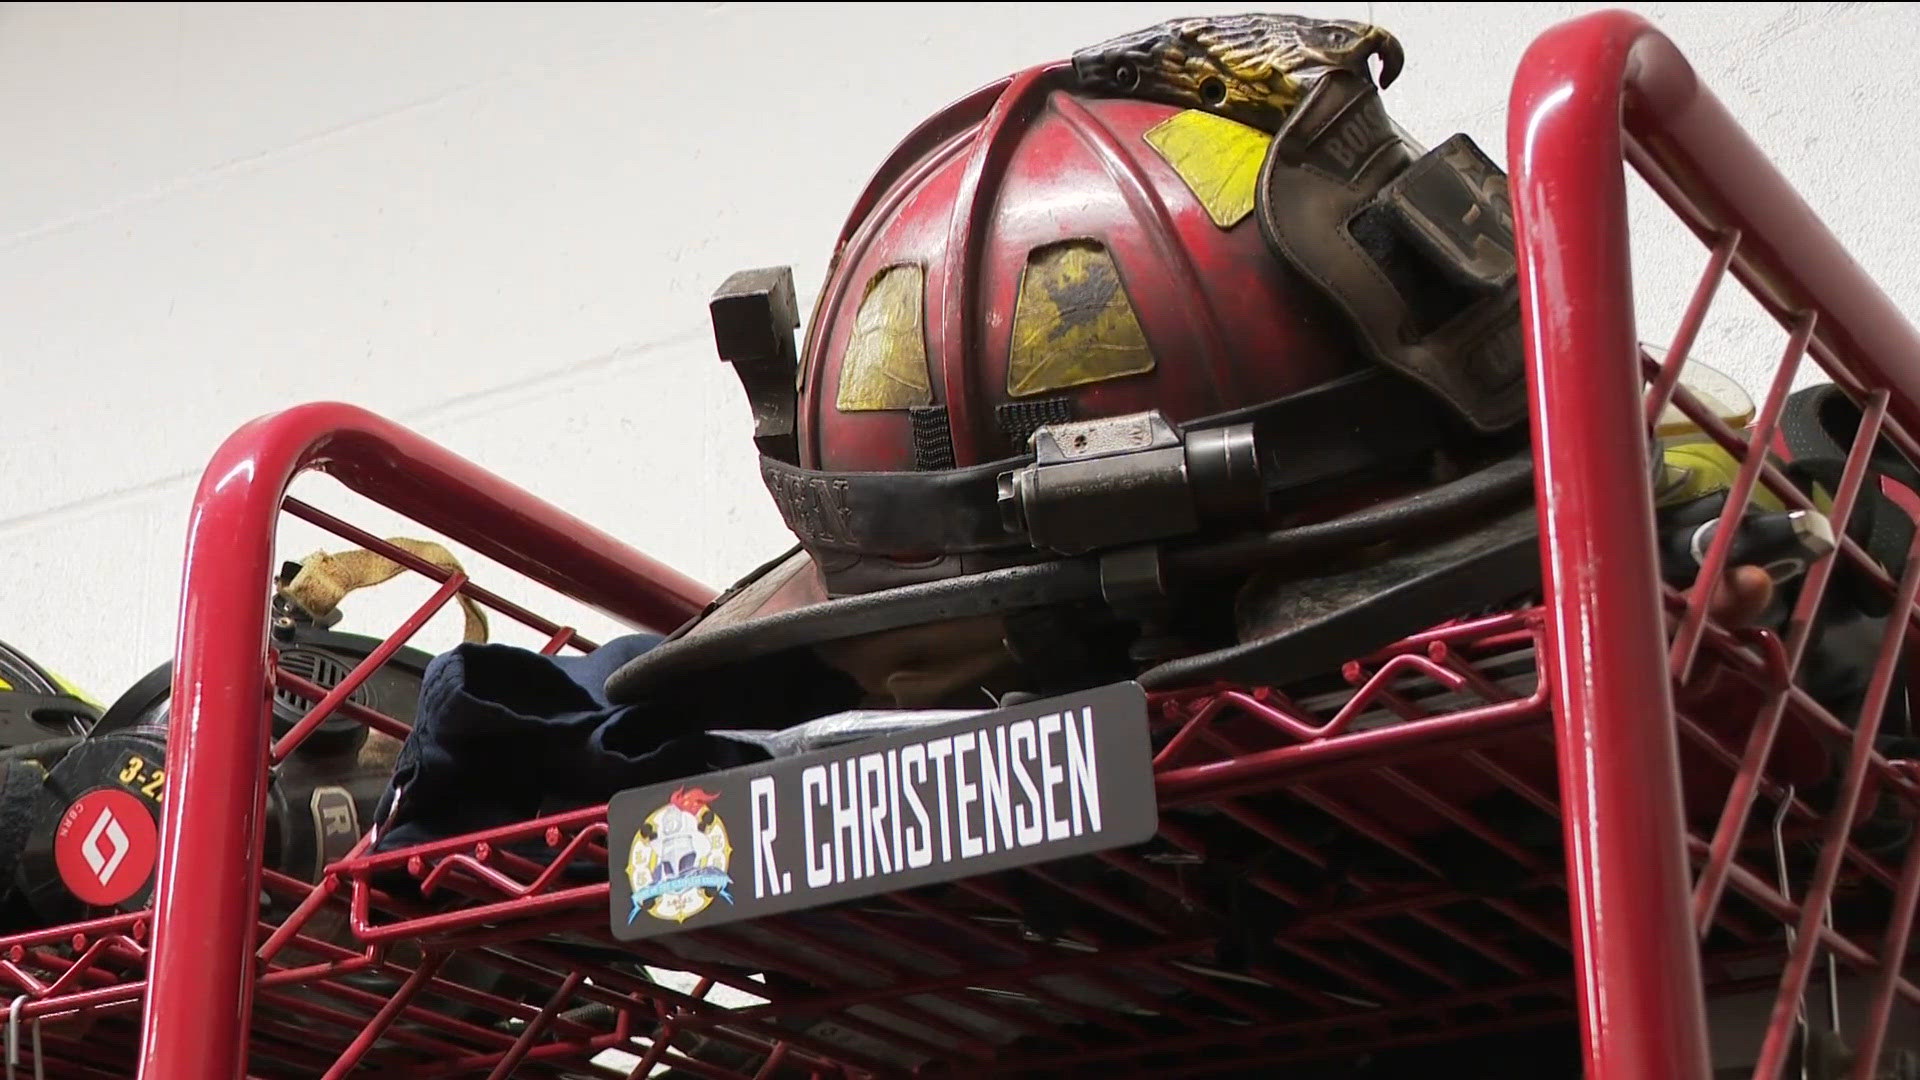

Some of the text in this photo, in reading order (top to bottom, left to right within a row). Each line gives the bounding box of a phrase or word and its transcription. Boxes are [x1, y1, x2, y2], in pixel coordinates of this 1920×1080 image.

[119, 757, 165, 803] 3-2
[750, 705, 1102, 898] R. CHRISTENSEN
[60, 803, 84, 837] CBRN
